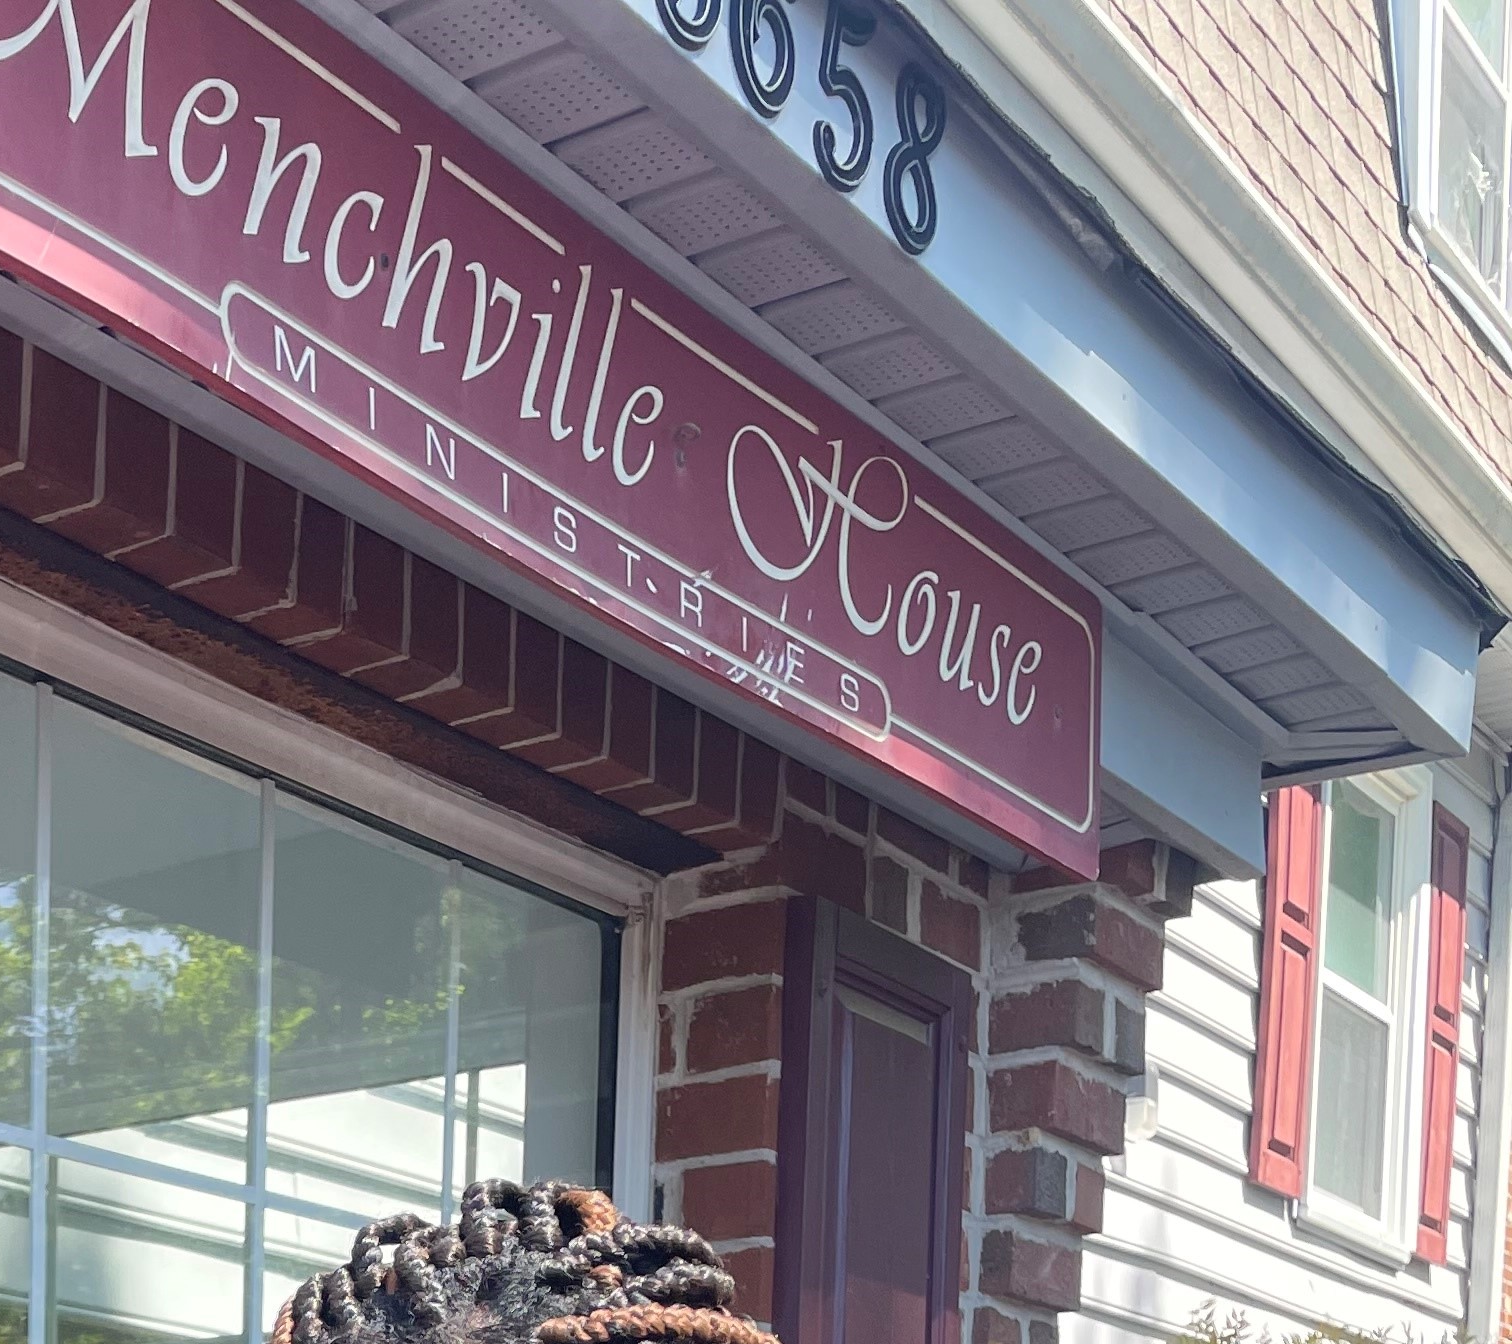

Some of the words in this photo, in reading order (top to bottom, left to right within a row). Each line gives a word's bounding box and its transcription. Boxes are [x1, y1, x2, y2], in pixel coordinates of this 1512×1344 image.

[655, 0, 947, 255] 658
[273, 325, 860, 712] MINISTRIES
[727, 424, 1044, 725] House
